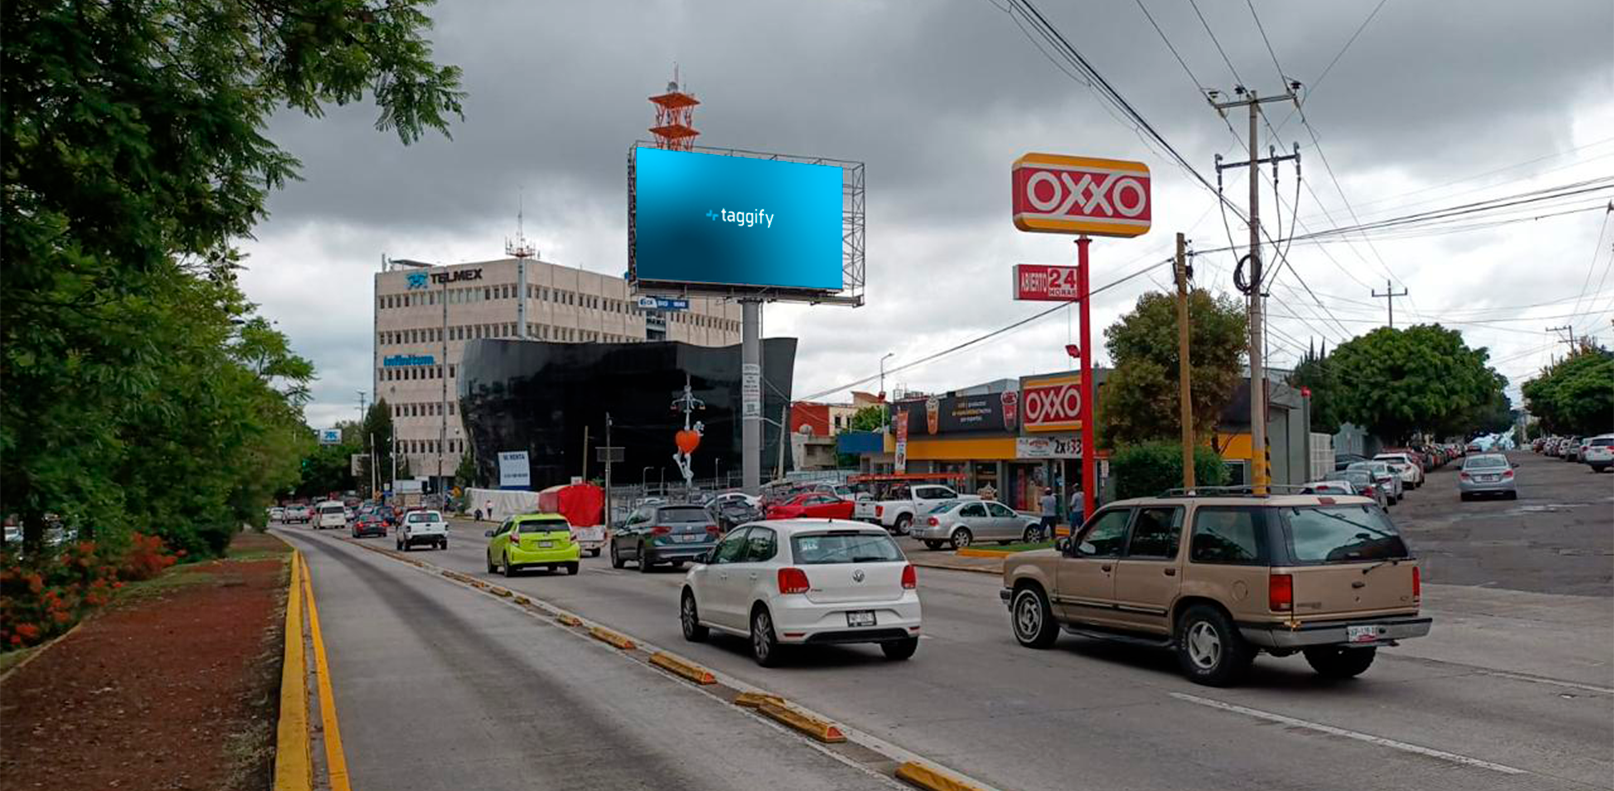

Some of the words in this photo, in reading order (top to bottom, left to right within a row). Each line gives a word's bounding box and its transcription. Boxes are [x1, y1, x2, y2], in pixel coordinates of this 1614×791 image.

[1026, 171, 1147, 217] OXXO
[721, 207, 774, 228] taggify
[430, 268, 482, 284] TELMEX
[1021, 271, 1048, 292] ABIERTO
[1049, 269, 1076, 289] 24
[1026, 386, 1081, 422] OXXO
